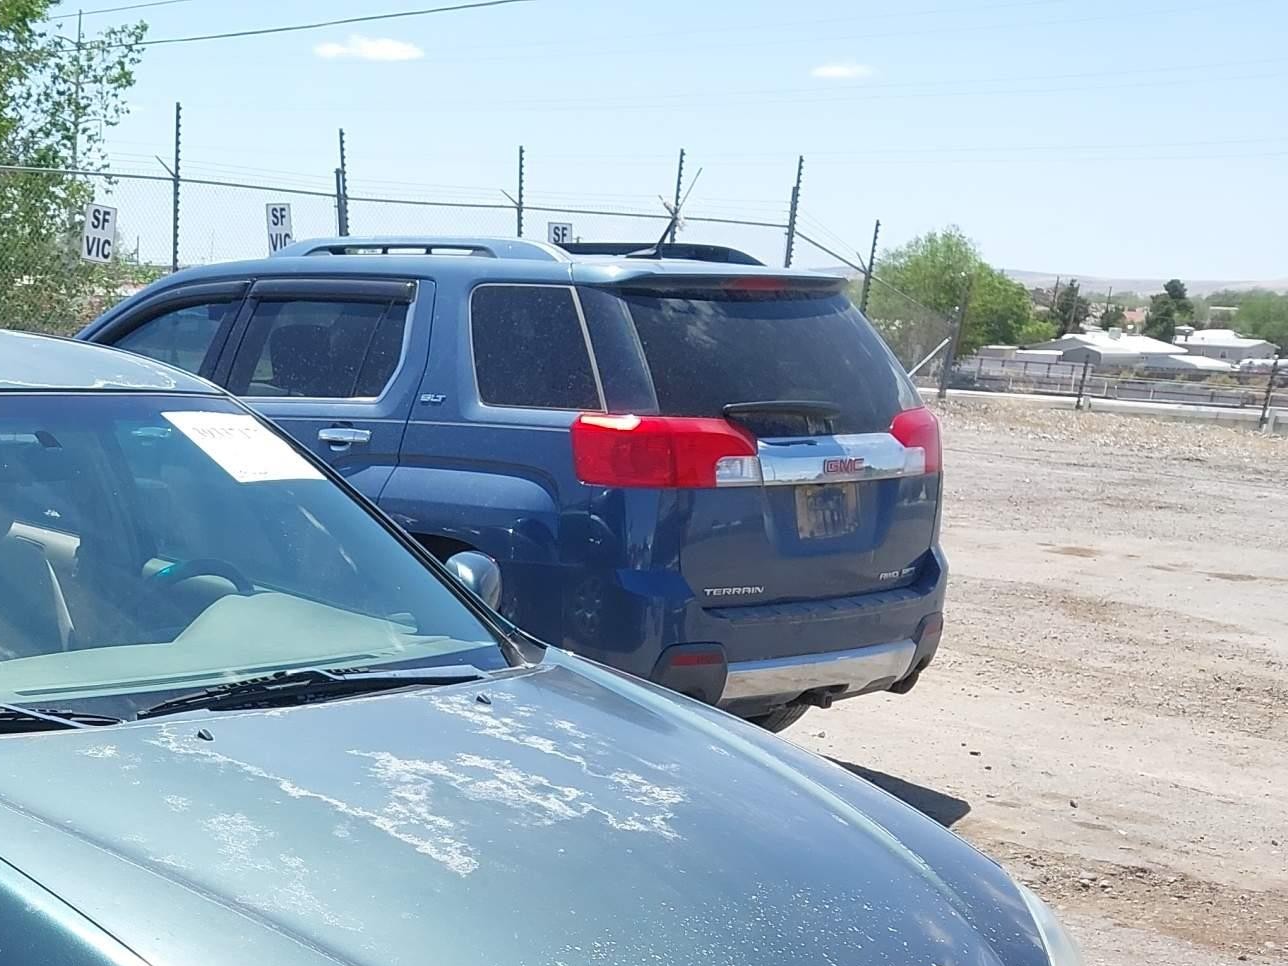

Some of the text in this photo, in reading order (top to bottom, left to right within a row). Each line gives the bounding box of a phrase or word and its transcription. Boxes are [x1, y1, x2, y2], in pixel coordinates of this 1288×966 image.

[91, 208, 111, 231] SF
[271, 207, 286, 226] SF
[553, 226, 568, 243] SF
[86, 235, 111, 260] VIC
[823, 457, 865, 474] GMC
[703, 586, 765, 597] TERRAIN
